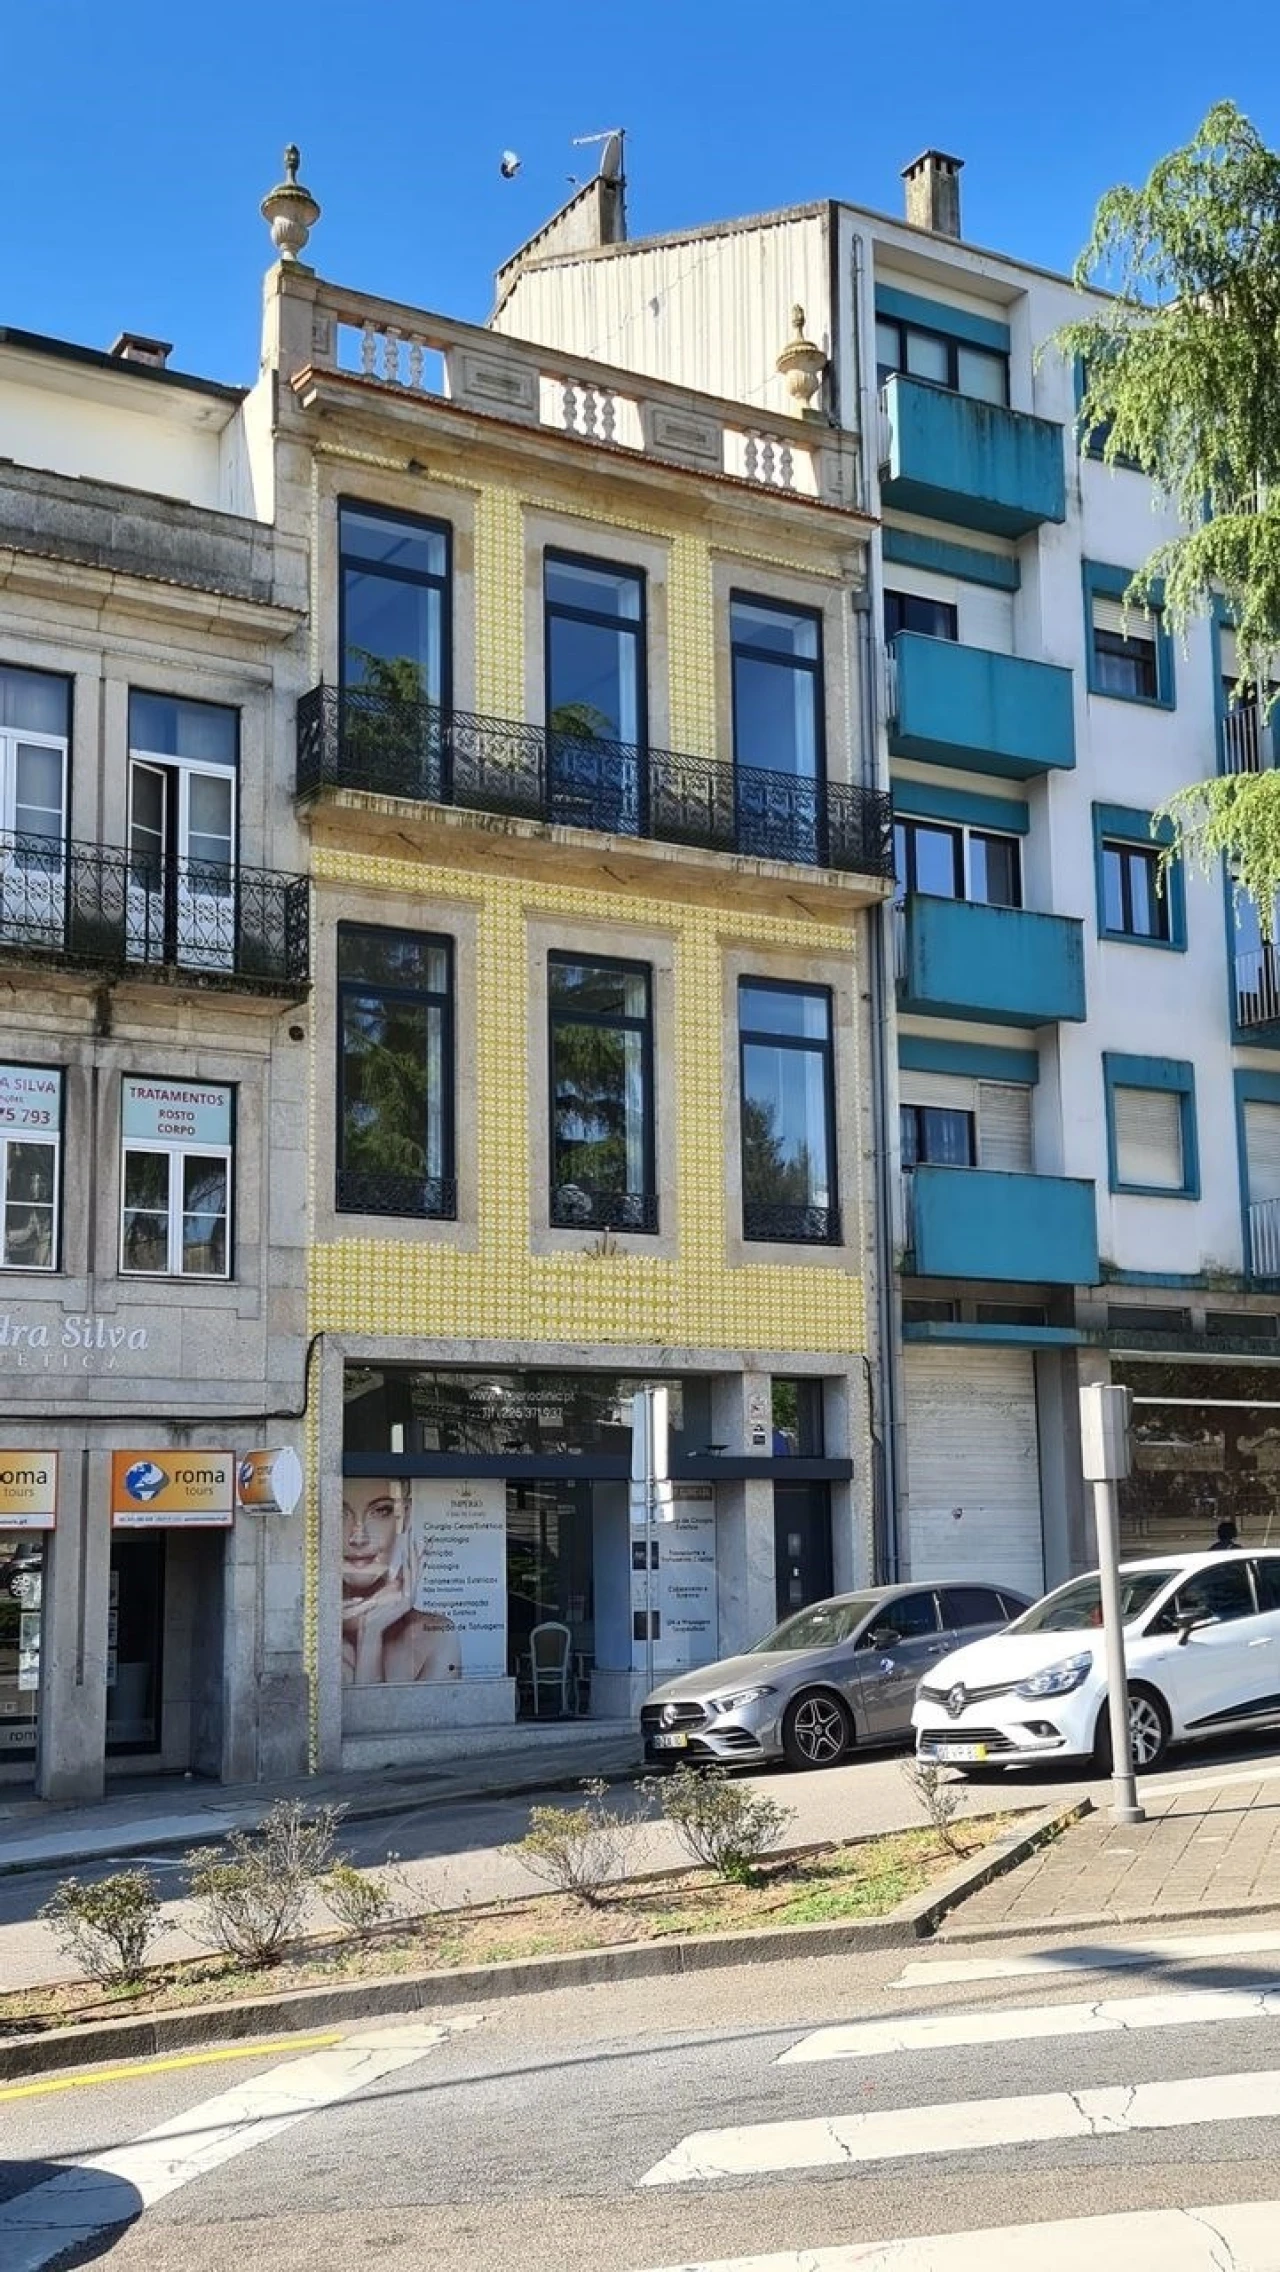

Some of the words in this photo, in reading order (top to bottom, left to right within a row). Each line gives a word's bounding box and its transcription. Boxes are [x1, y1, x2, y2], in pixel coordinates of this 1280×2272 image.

[14, 1078, 56, 1094] SILVA
[130, 1087, 225, 1107] TRATAMENTOS
[21, 1108, 51, 1124] 793
[158, 1109, 196, 1121] ROSTO
[157, 1123, 196, 1136] CORPO
[61, 1316, 150, 1350] Silva
[0, 1470, 47, 1485] oma
[175, 1469, 225, 1483] roma
[186, 1486, 214, 1497] tours
